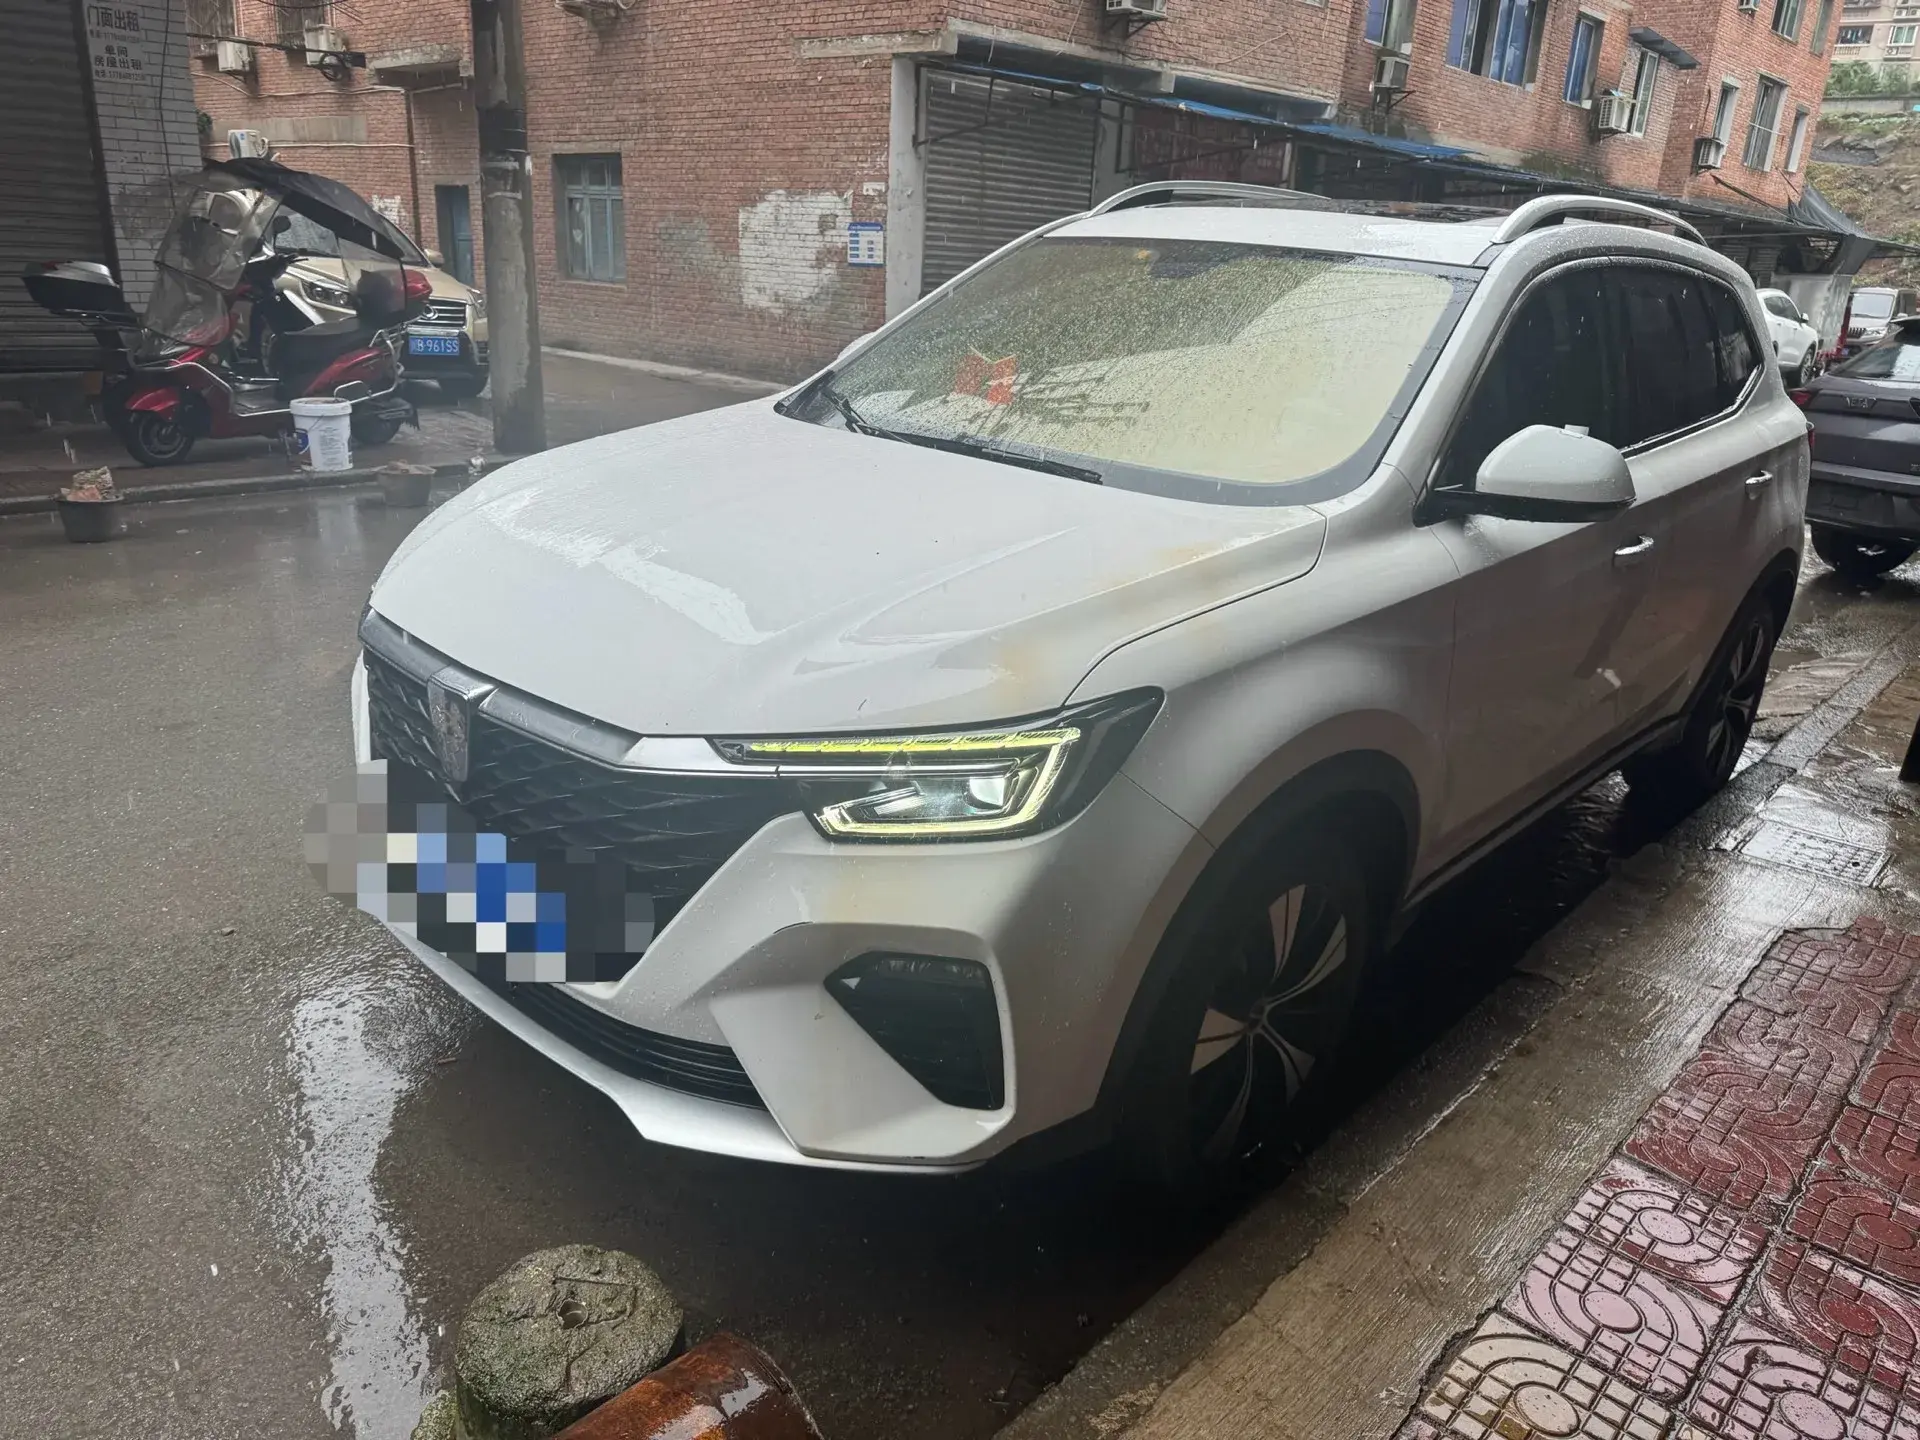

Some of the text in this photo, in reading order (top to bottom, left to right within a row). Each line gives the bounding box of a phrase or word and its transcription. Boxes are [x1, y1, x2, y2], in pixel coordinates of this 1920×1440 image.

[87, 4, 140, 31] 门面出租
[105, 45, 128, 57] 单间
[94, 54, 142, 71] 房屋出租
